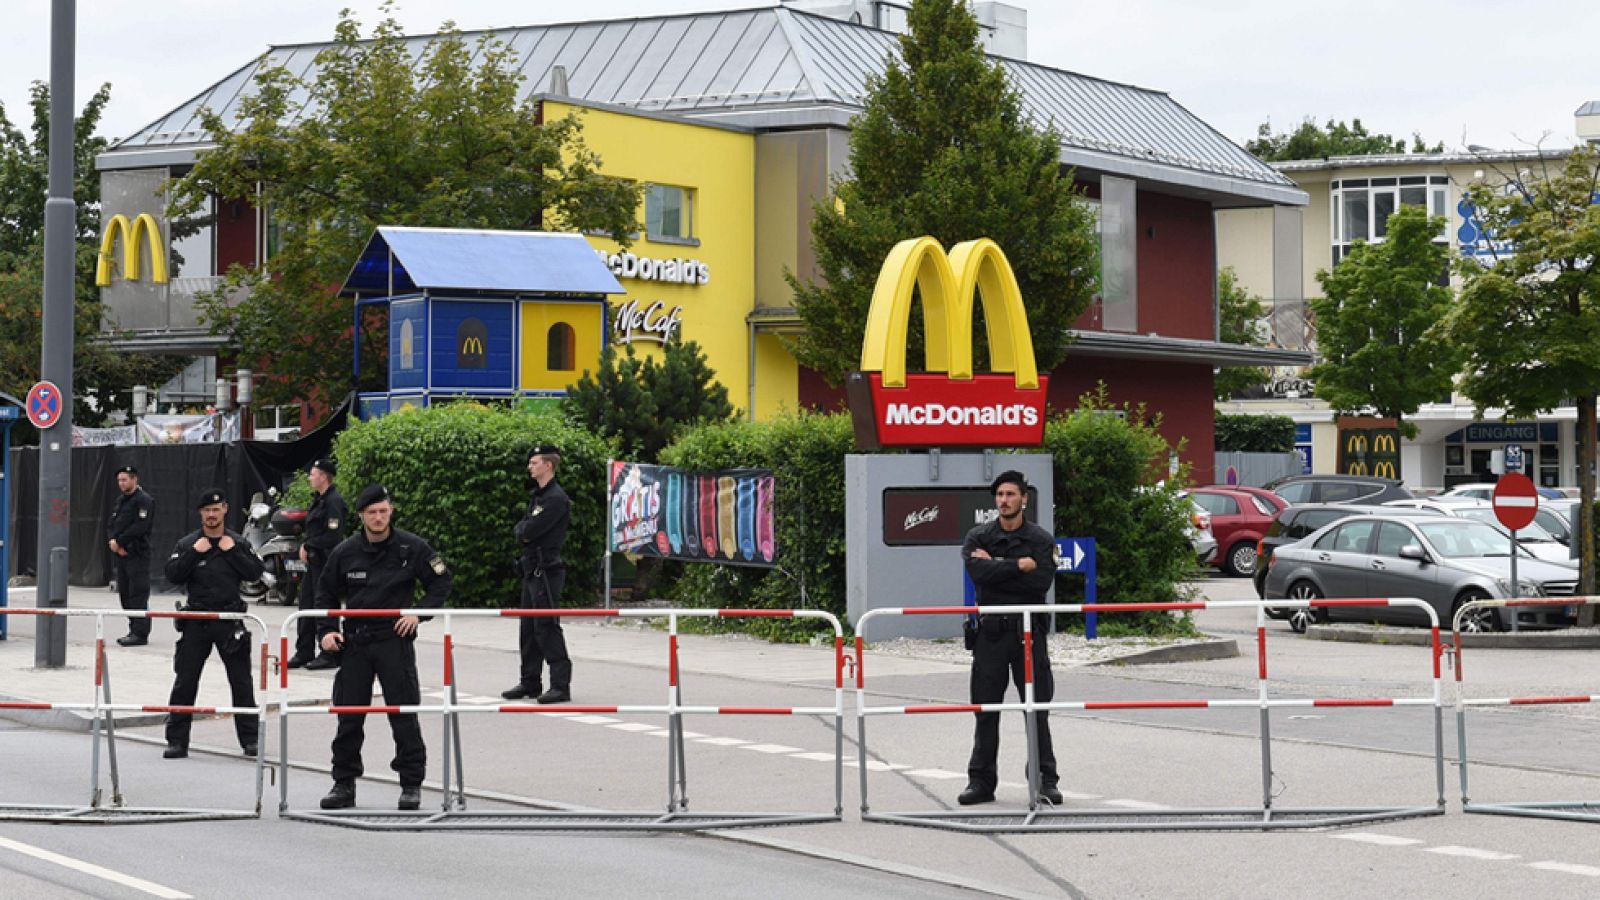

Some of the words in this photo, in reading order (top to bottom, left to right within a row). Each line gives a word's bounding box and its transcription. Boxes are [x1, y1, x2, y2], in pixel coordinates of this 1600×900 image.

[886, 404, 1039, 427] McDonald's
[1469, 426, 1534, 439] EINGANG
[612, 481, 661, 528] GRATIS
